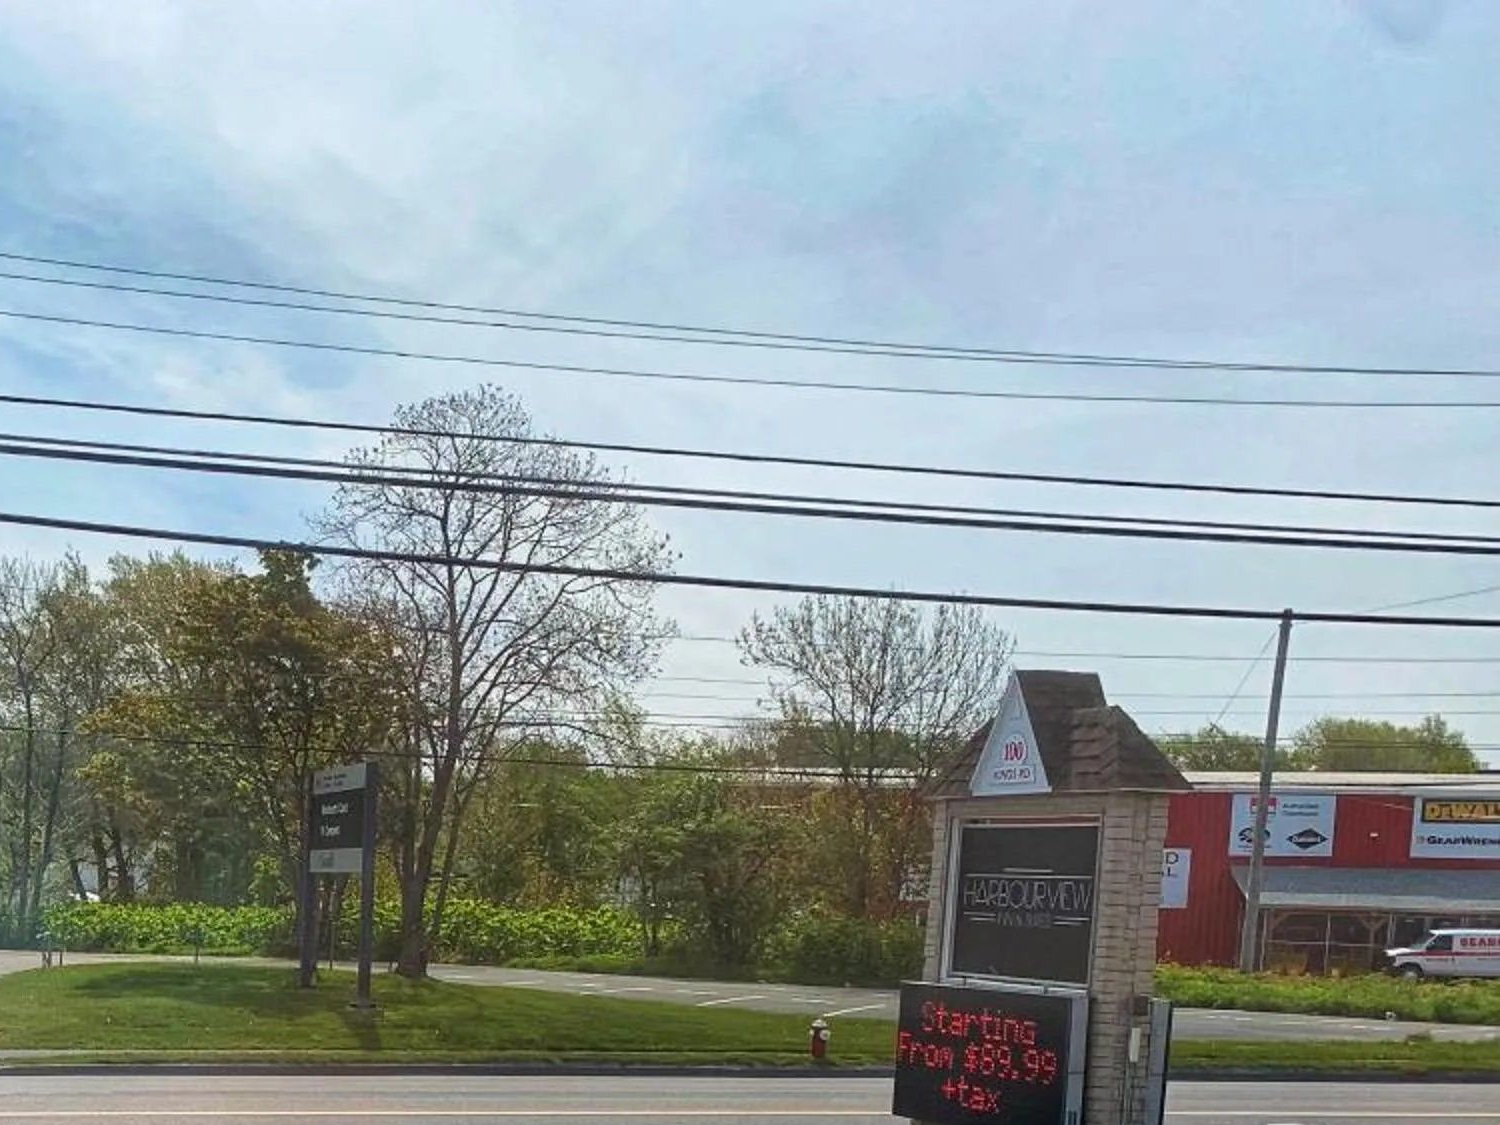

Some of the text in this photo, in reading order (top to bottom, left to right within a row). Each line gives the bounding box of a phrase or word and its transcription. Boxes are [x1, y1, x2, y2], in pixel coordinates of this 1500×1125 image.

[962, 879, 1092, 911] HARBOURVIEW
[920, 1001, 1038, 1046] Starting
[898, 1031, 953, 1069] From
[940, 1075, 1000, 1114] +tax
